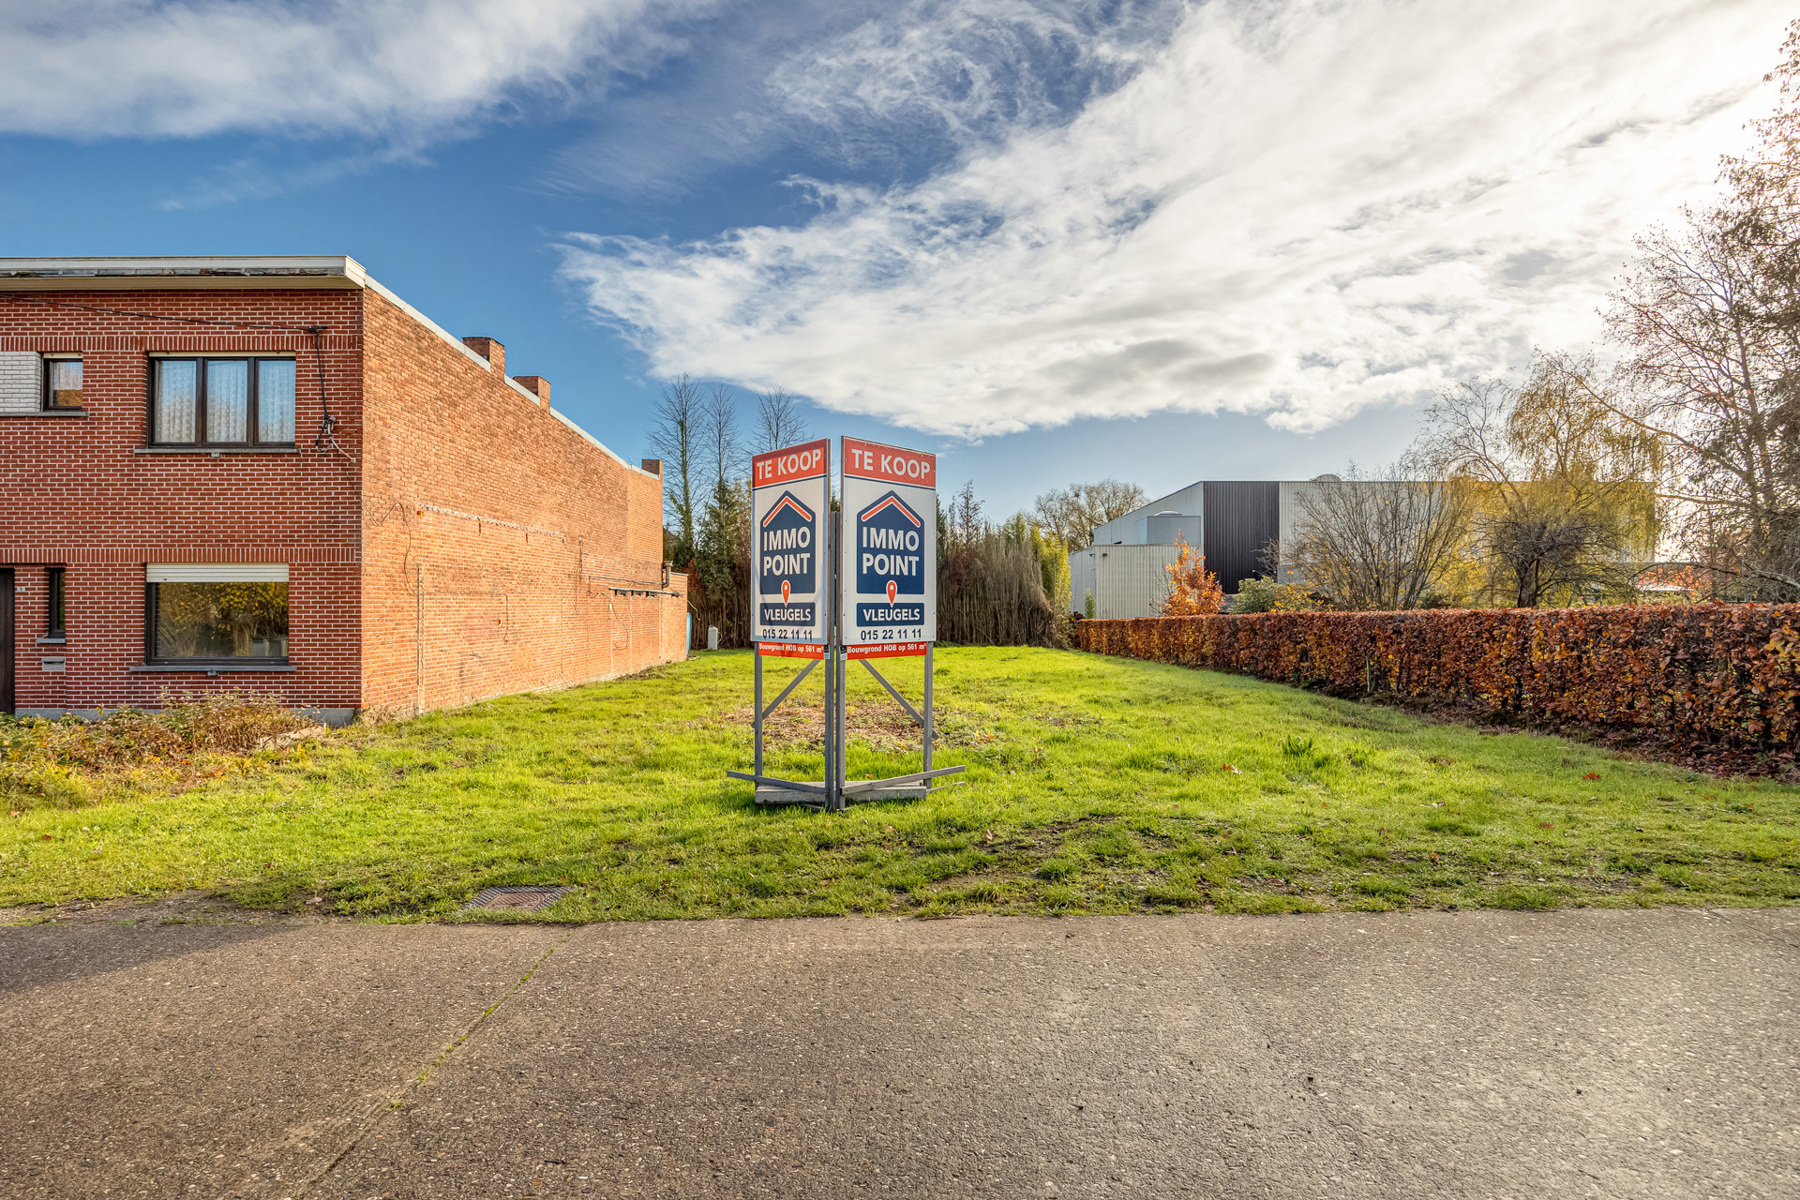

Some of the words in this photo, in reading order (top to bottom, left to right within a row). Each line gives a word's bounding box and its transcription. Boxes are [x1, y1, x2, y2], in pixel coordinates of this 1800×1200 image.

[757, 460, 772, 480] TE
[778, 449, 821, 476] KOOP
[852, 449, 874, 471] TE
[881, 454, 930, 479] KOOP
[764, 526, 810, 551] IMMO
[862, 526, 919, 551] IMMO
[764, 553, 810, 576] POINT
[862, 553, 919, 576] POINT
[764, 608, 811, 621] VLEUGELS
[863, 608, 920, 621] VLEUGELS
[762, 628, 776, 638] 015
[778, 630, 788, 639] 22
[791, 630, 800, 639] 11
[803, 630, 812, 640] 11
[861, 630, 878, 640] 015
[882, 630, 893, 639] 22
[897, 629, 907, 638] 11
[912, 629, 921, 638] 11
[847, 646, 882, 654] Bouwgrond
